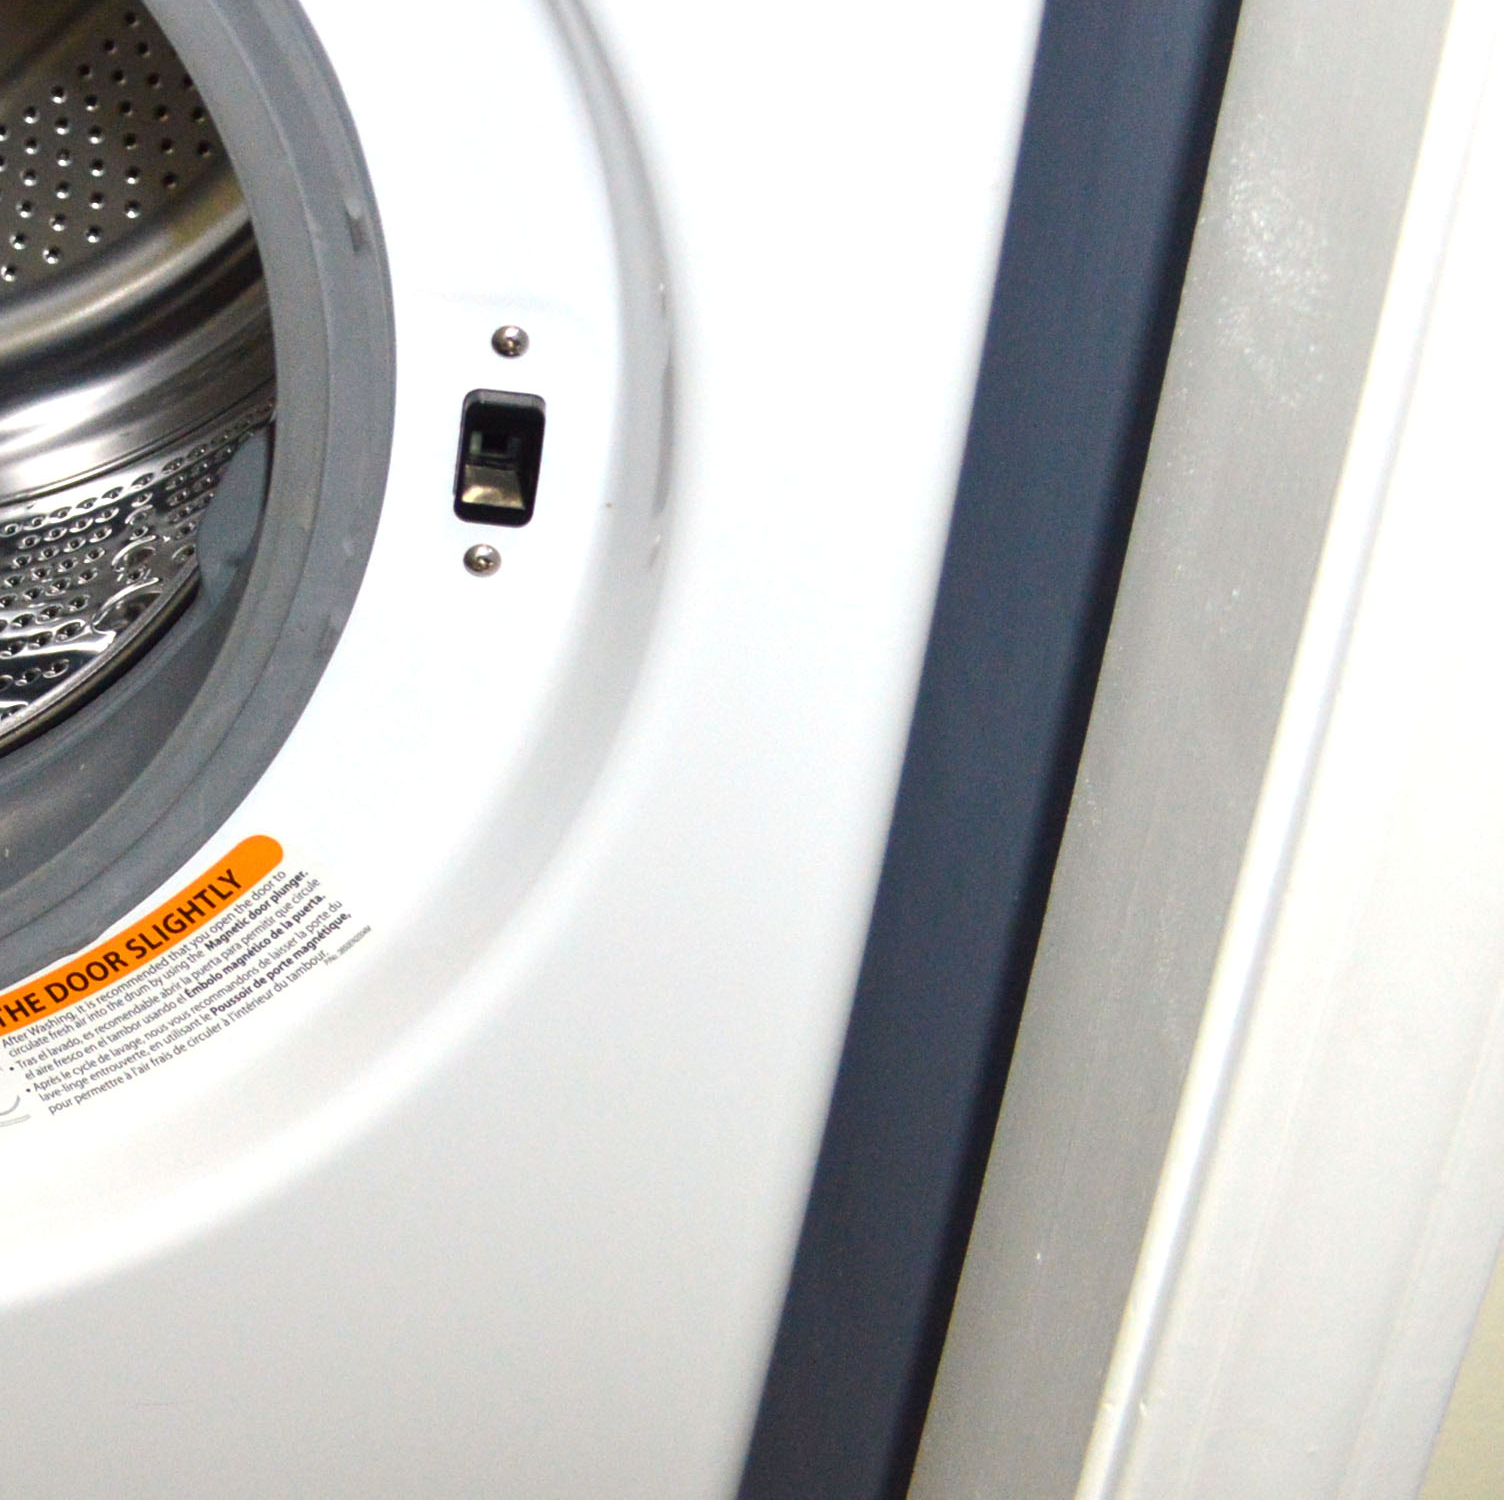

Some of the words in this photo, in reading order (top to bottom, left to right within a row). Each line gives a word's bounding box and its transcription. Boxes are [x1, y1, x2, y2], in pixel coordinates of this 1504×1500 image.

[1, 1031, 31, 1049] After
[74, 1004, 88, 1016] it
[83, 1000, 97, 1010] is
[95, 956, 172, 1005] recommended
[167, 944, 192, 962] that
[188, 931, 211, 950] you
[209, 912, 239, 934] open
[232, 899, 254, 915] the
[250, 879, 276, 902] door
[271, 870, 287, 883] to
[8, 1035, 50, 1058] circulate
[47, 1024, 75, 1041] fresh
[73, 1017, 88, 1029] air
[85, 1007, 108, 1023] into
[105, 998, 125, 1012] the
[123, 983, 151, 1003] drum
[147, 976, 164, 988] by
[162, 960, 191, 980] using
[186, 950, 206, 964] the
[203, 917, 251, 952] Magnetic
[247, 899, 272, 921] door
[269, 870, 309, 905] plunger.
[15, 1056, 39, 1069] Tras
[37, 1049, 49, 1062] el
[82, 1030, 95, 1041] es
[93, 995, 161, 1035] recomendable
[159, 981, 183, 1000] abrir
[178, 976, 193, 990] la
[190, 956, 223, 982] puerta
[219, 942, 243, 962] para
[240, 915, 277, 947] permitir
[274, 901, 294, 919] que
[291, 878, 321, 905] circule
[24, 1069, 36, 1081] el
[35, 1063, 55, 1077] aire
[52, 1050, 85, 1068] fresco
[83, 1043, 99, 1055] en
[97, 1036, 109, 1048] el
[105, 1020, 142, 1043] tambor
[141, 1001, 178, 1025] usando
[176, 993, 188, 1005] el
[221, 937, 272, 976] magnético
[269, 927, 285, 940] de
[279, 920, 295, 931] la
[290, 894, 327, 925] puerta.
[32, 1075, 63, 1092] Après
[59, 1070, 73, 1080] le
[72, 1059, 98, 1076] cycle
[96, 1053, 112, 1064] de
[143, 1023, 169, 1041] nous
[167, 1010, 192, 1027] vous
[189, 966, 260, 1015] recommandons
[257, 957, 272, 970] de
[267, 936, 299, 961] laisser
[294, 930, 308, 940] la
[304, 911, 331, 935] porte
[327, 900, 343, 913] du
[38, 1077, 89, 1102] lave-linge
[148, 1040, 164, 1052] en
[162, 1018, 203, 1045] utilisant
[198, 1013, 213, 1023] le
[208, 985, 254, 1017] Poussoir
[252, 976, 268, 989] de
[265, 957, 295, 982] porte
[291, 912, 352, 961] magnétique,
[44, 952, 128, 1003] DOOR
[126, 869, 241, 959] SLIGHTLY
[47, 1098, 73, 1116] pour
[73, 1076, 125, 1106] permettre
[149, 1051, 174, 1067] frais
[172, 1043, 188, 1056] de
[186, 1022, 223, 1048] circuler
[273, 979, 289, 993] du
